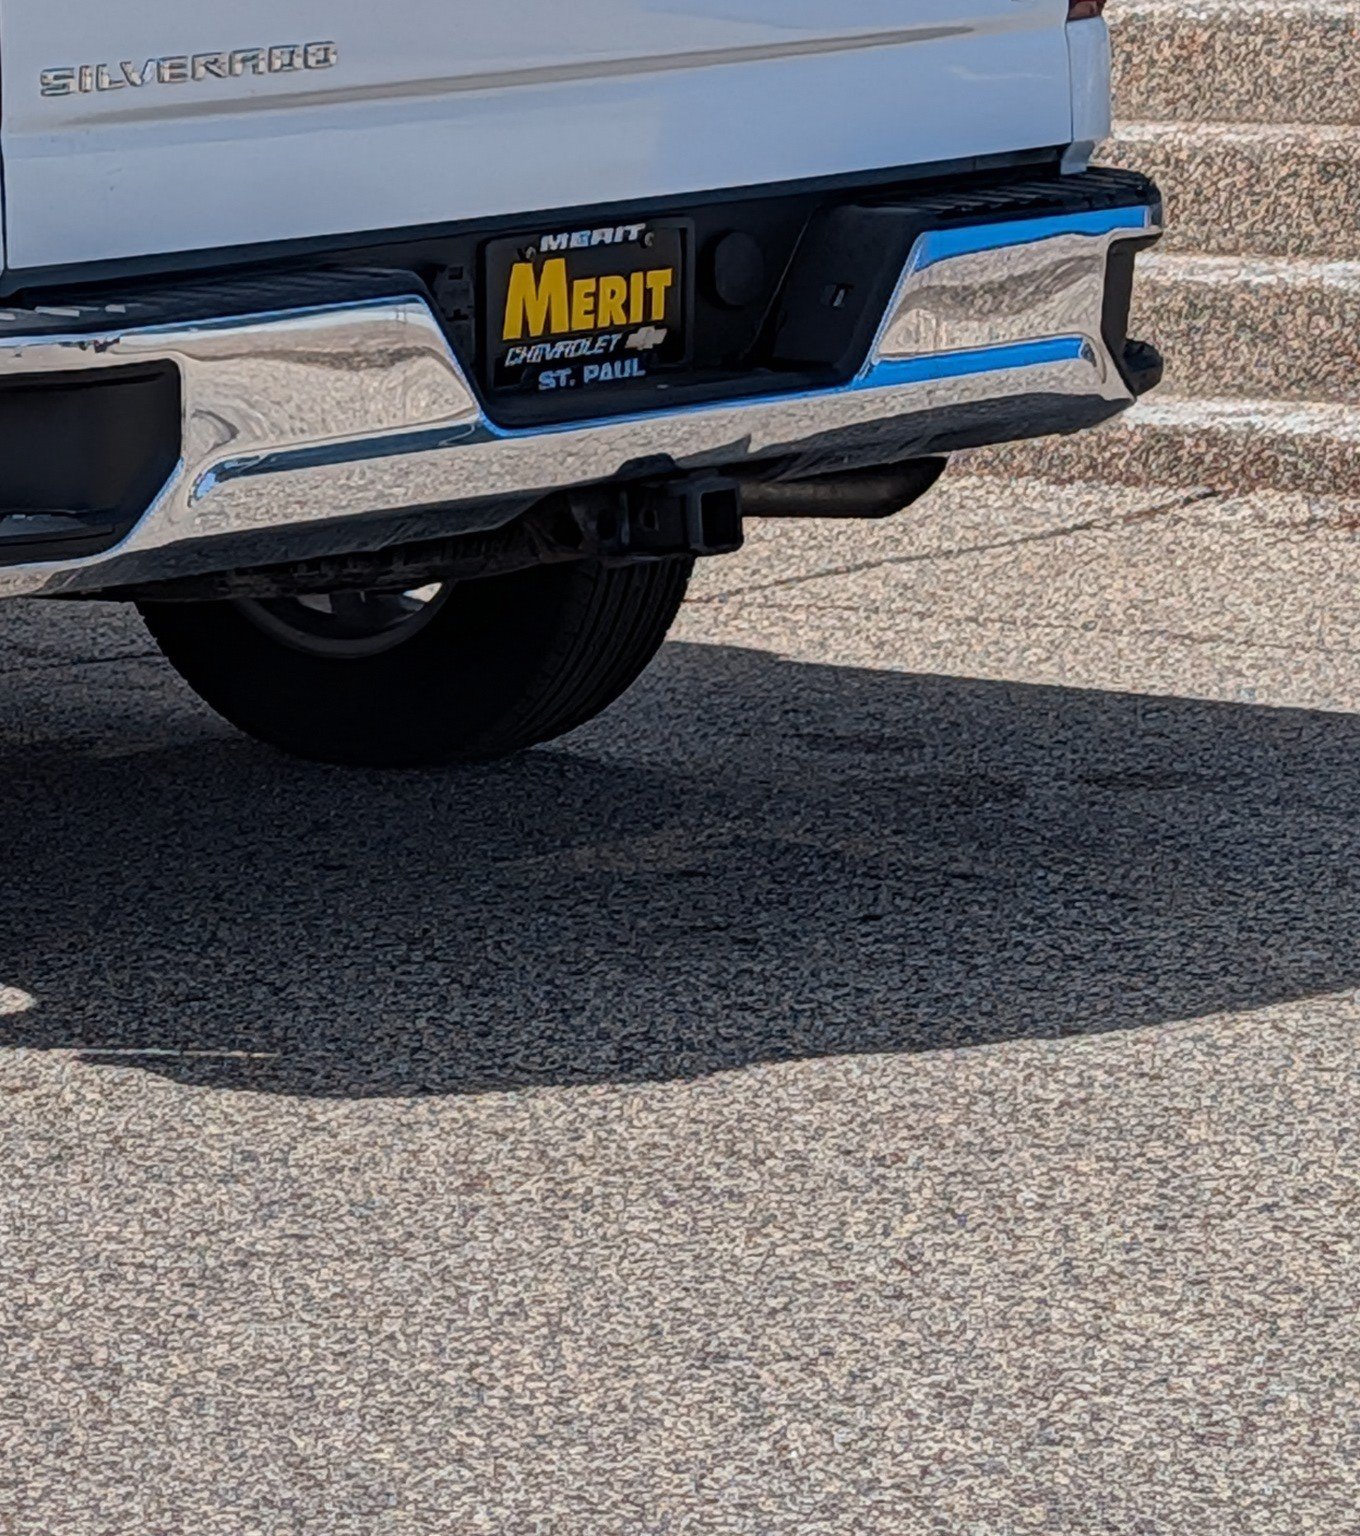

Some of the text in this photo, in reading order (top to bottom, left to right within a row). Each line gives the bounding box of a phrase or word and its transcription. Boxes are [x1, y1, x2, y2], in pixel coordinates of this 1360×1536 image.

[40, 41, 337, 97] SILVERADO
[540, 223, 646, 252] MERIT
[502, 258, 672, 340] MERIT
[504, 333, 623, 367] CHEVROLET
[538, 358, 646, 390] ST. PAUL
